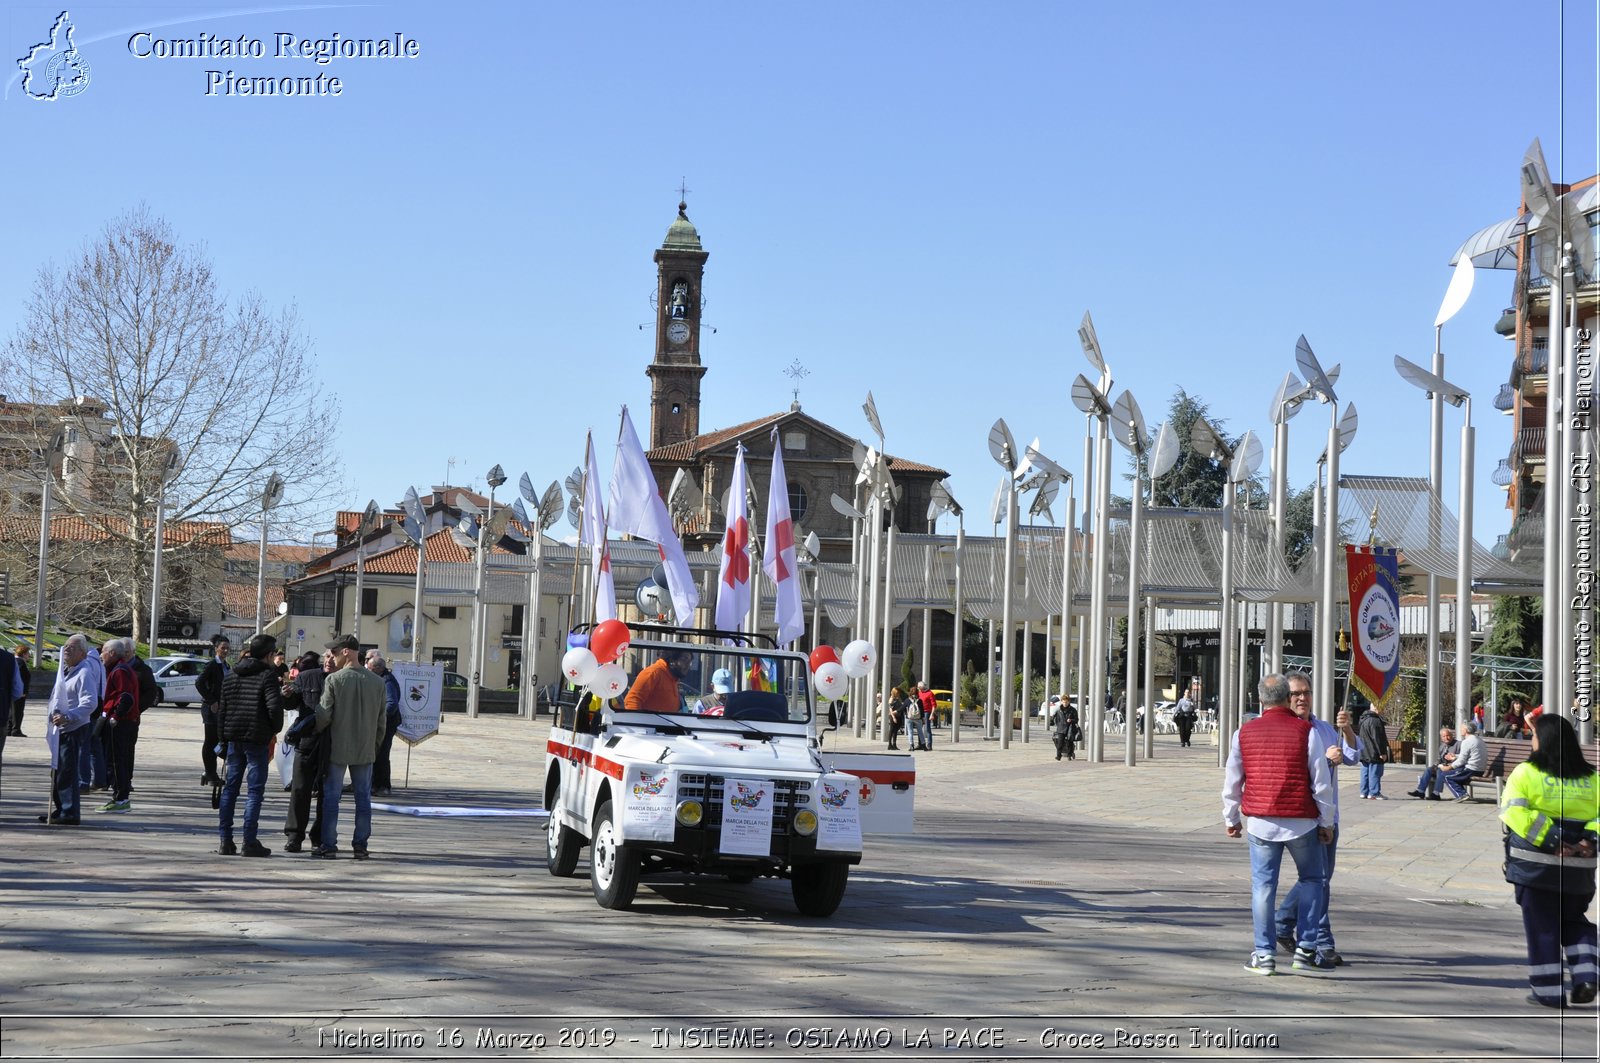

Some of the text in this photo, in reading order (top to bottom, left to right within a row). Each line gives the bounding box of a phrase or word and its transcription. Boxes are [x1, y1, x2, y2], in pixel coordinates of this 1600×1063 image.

[1362, 591, 1378, 624] COMITATO
[400, 669, 436, 678] NICHELINO
[1543, 775, 1592, 788] CIVILE
